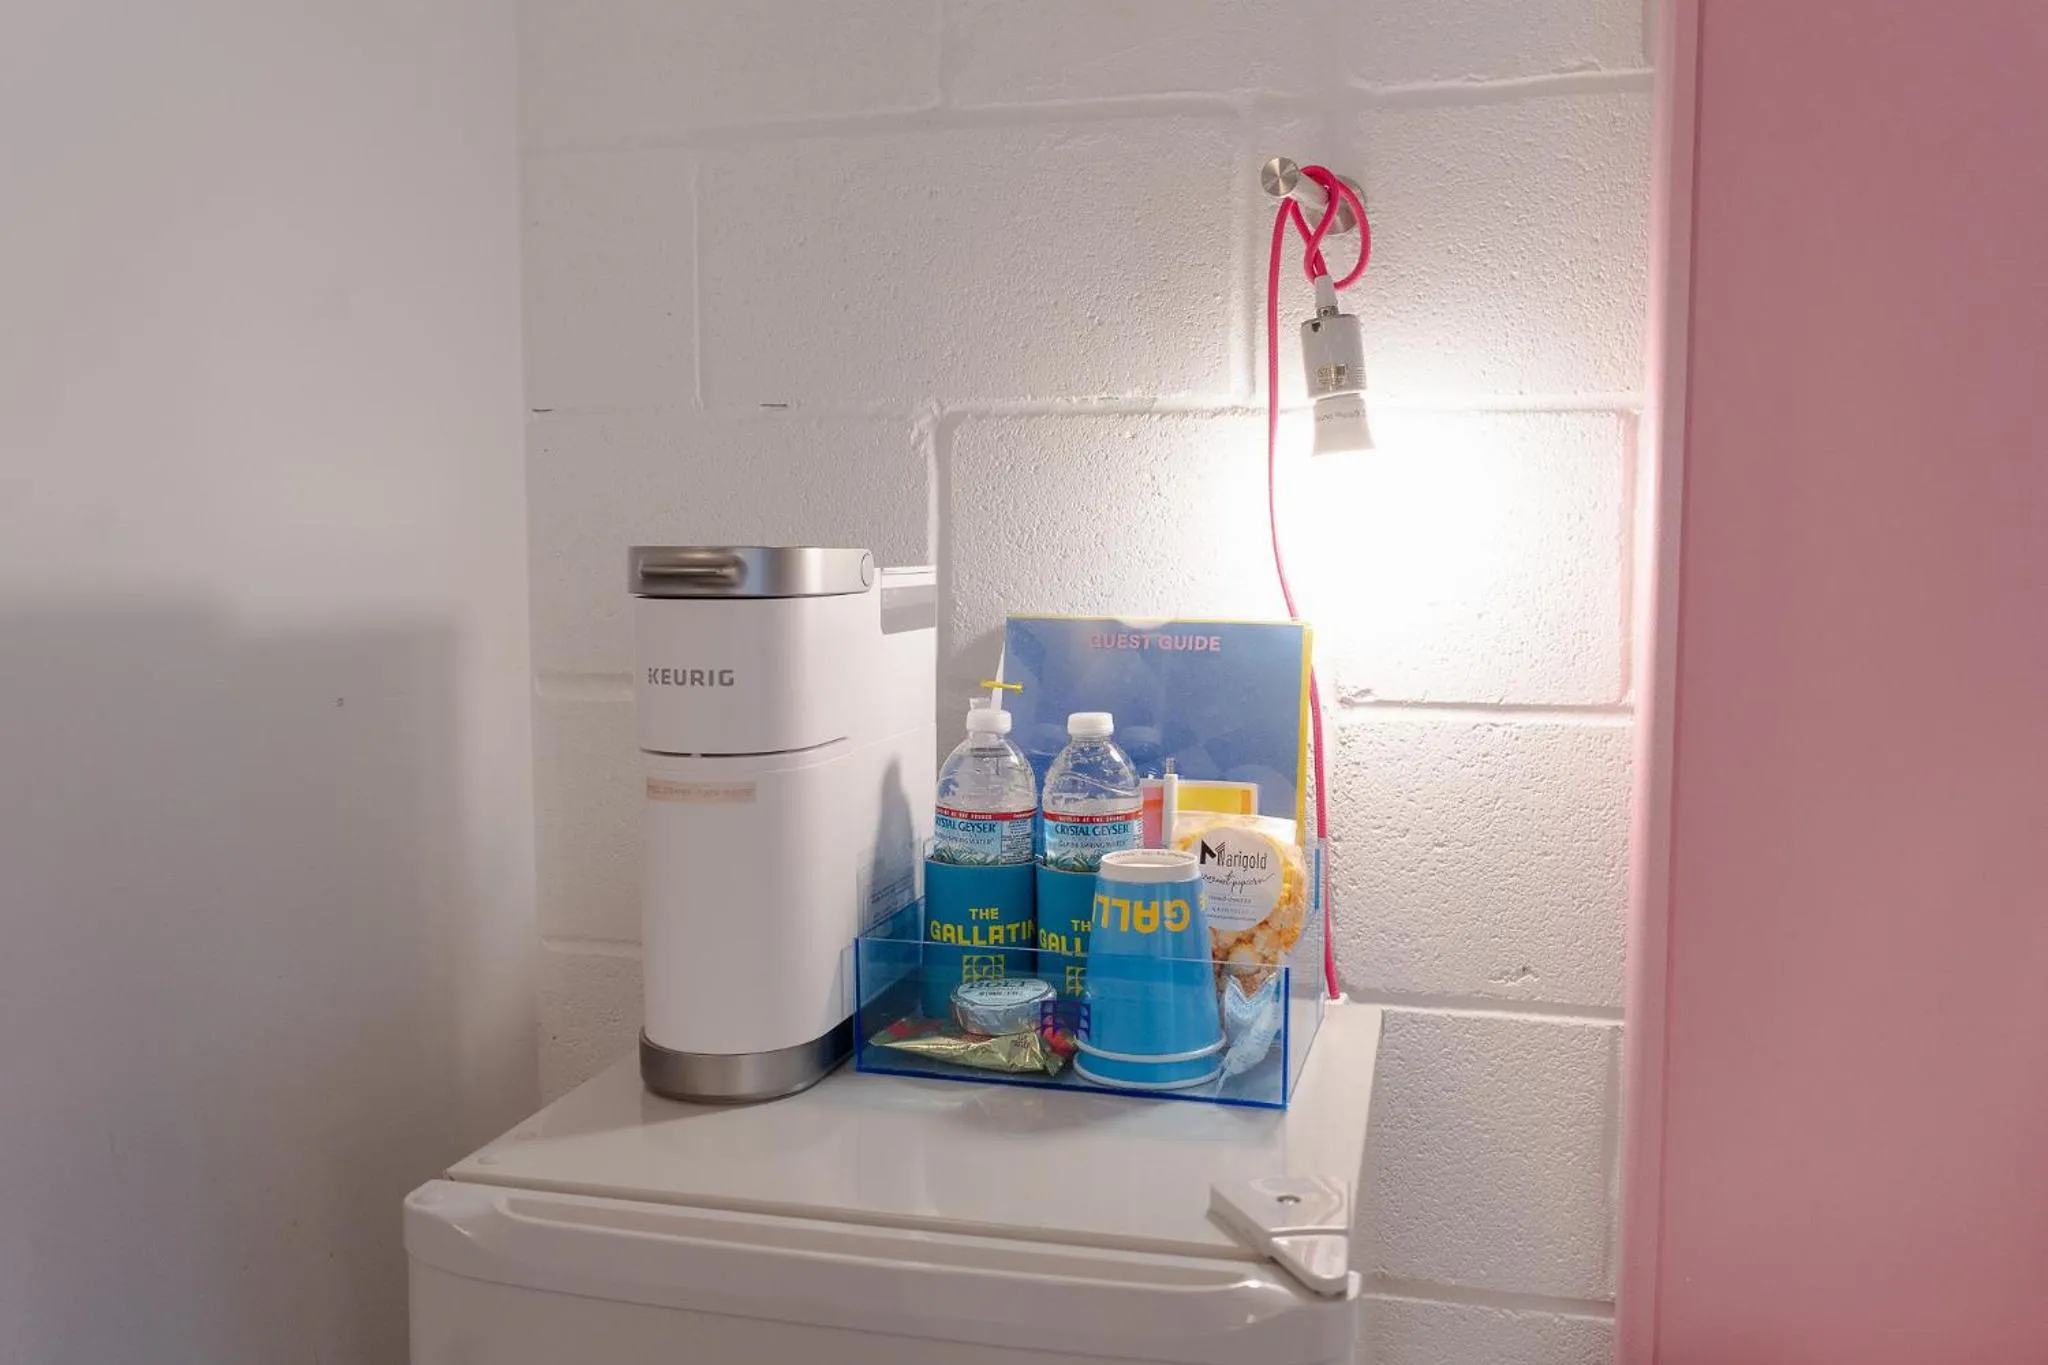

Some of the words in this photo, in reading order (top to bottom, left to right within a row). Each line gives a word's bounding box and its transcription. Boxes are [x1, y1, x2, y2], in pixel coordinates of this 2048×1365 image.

[1091, 633, 1150, 650] GUEST
[1158, 635, 1222, 652] GUIDE
[648, 668, 735, 687] KEURIG
[959, 820, 996, 834] GEYSER
[1054, 823, 1090, 837] CRYSTAL
[1092, 822, 1129, 836] GEYSER
[1199, 839, 1268, 873] Marigold
[968, 907, 1000, 921] THE
[1092, 893, 1191, 935] GALL
[1070, 919, 1092, 933] TH
[1039, 927, 1089, 958] GALL
